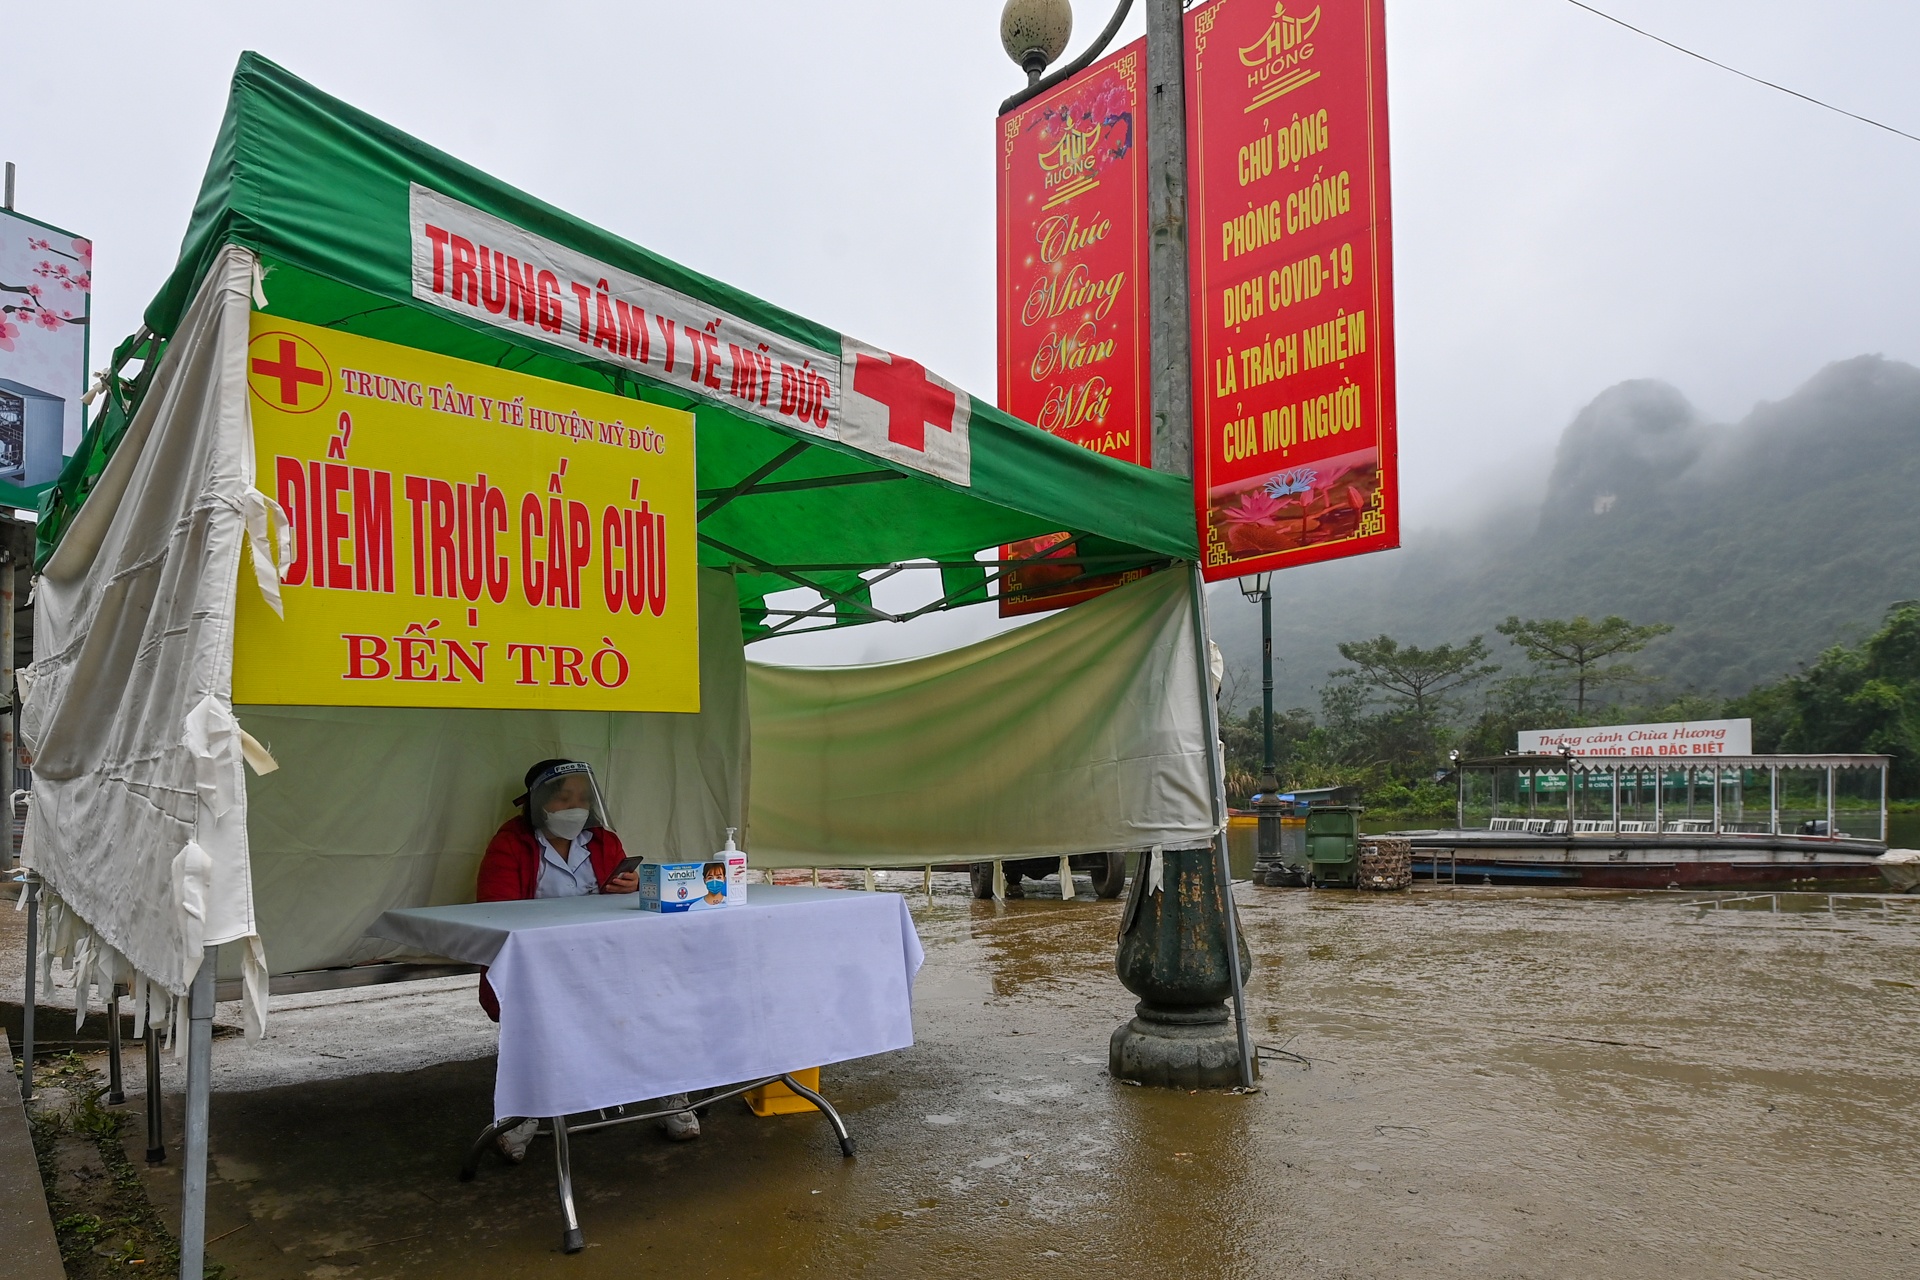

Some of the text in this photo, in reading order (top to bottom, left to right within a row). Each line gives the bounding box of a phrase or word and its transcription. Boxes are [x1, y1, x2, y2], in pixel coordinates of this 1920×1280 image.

[1247, 42, 1314, 88] HƯƠNG
[1238, 108, 1329, 187] CHỦ ĐỘNG
[1036, 211, 1112, 264] Chúc
[1222, 166, 1350, 261] PHÒNG CHỐNG
[1021, 263, 1126, 327] Mừng
[1223, 243, 1353, 334] DỊCH COVID-19
[424, 223, 832, 430] TRUNG TÂM Y TẾ MỸ ĐỨC
[1030, 321, 1117, 382] Năm
[1216, 308, 1366, 398] LÀ TRÁCH NHIỆM
[341, 368, 666, 455] TRUNG TÂM Y TẾ HUYỆN MỸ ĐỨC
[1036, 376, 1112, 433] Mới
[1223, 376, 1361, 463] CỦA MỌI NGƯỜI
[275, 411, 667, 628] ĐIỂM TRỰC CẤP CỨU
[341, 618, 630, 690] BẾN TRÒ
[1539, 728, 1726, 746] Thắng cảnh Chùa Hương
[1631, 746, 1654, 755] GIA
[668, 870, 696, 879] vinakit
